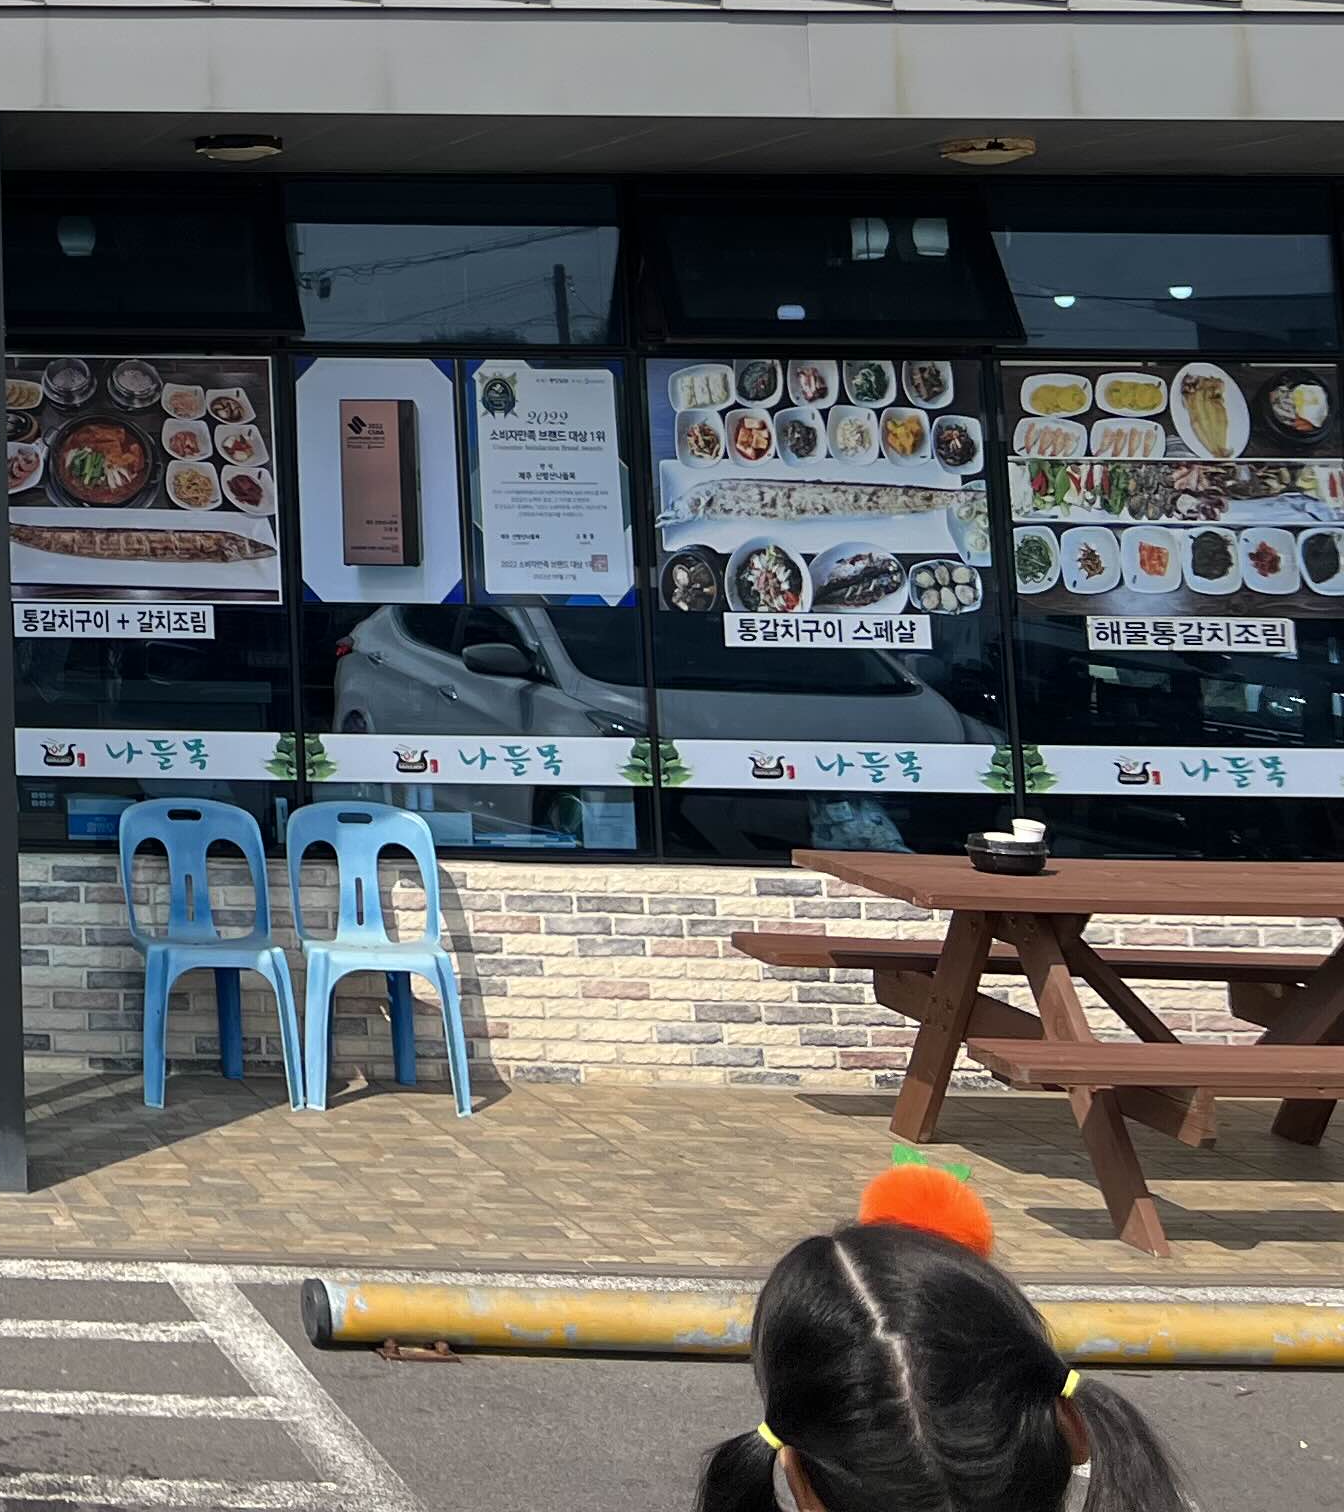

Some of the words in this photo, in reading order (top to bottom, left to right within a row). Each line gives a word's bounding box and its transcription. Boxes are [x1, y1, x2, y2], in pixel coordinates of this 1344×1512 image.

[527, 410, 569, 425] 2022
[490, 429, 537, 442] 소비자만족
[538, 430, 568, 442] 브랜드
[569, 430, 587, 442] 대상
[590, 430, 605, 442] 1위
[20, 608, 110, 635] 통갈치구이
[117, 615, 130, 629] +
[136, 609, 207, 635] 갈치조림
[737, 618, 843, 643] 통갈치구이
[852, 619, 917, 644] 스페샬
[1094, 619, 1287, 648] 해물통갈치조림
[105, 737, 210, 771] 나들목
[457, 740, 564, 777] 나들목
[815, 750, 923, 784] 나들목
[1179, 755, 1288, 788] 나들목
